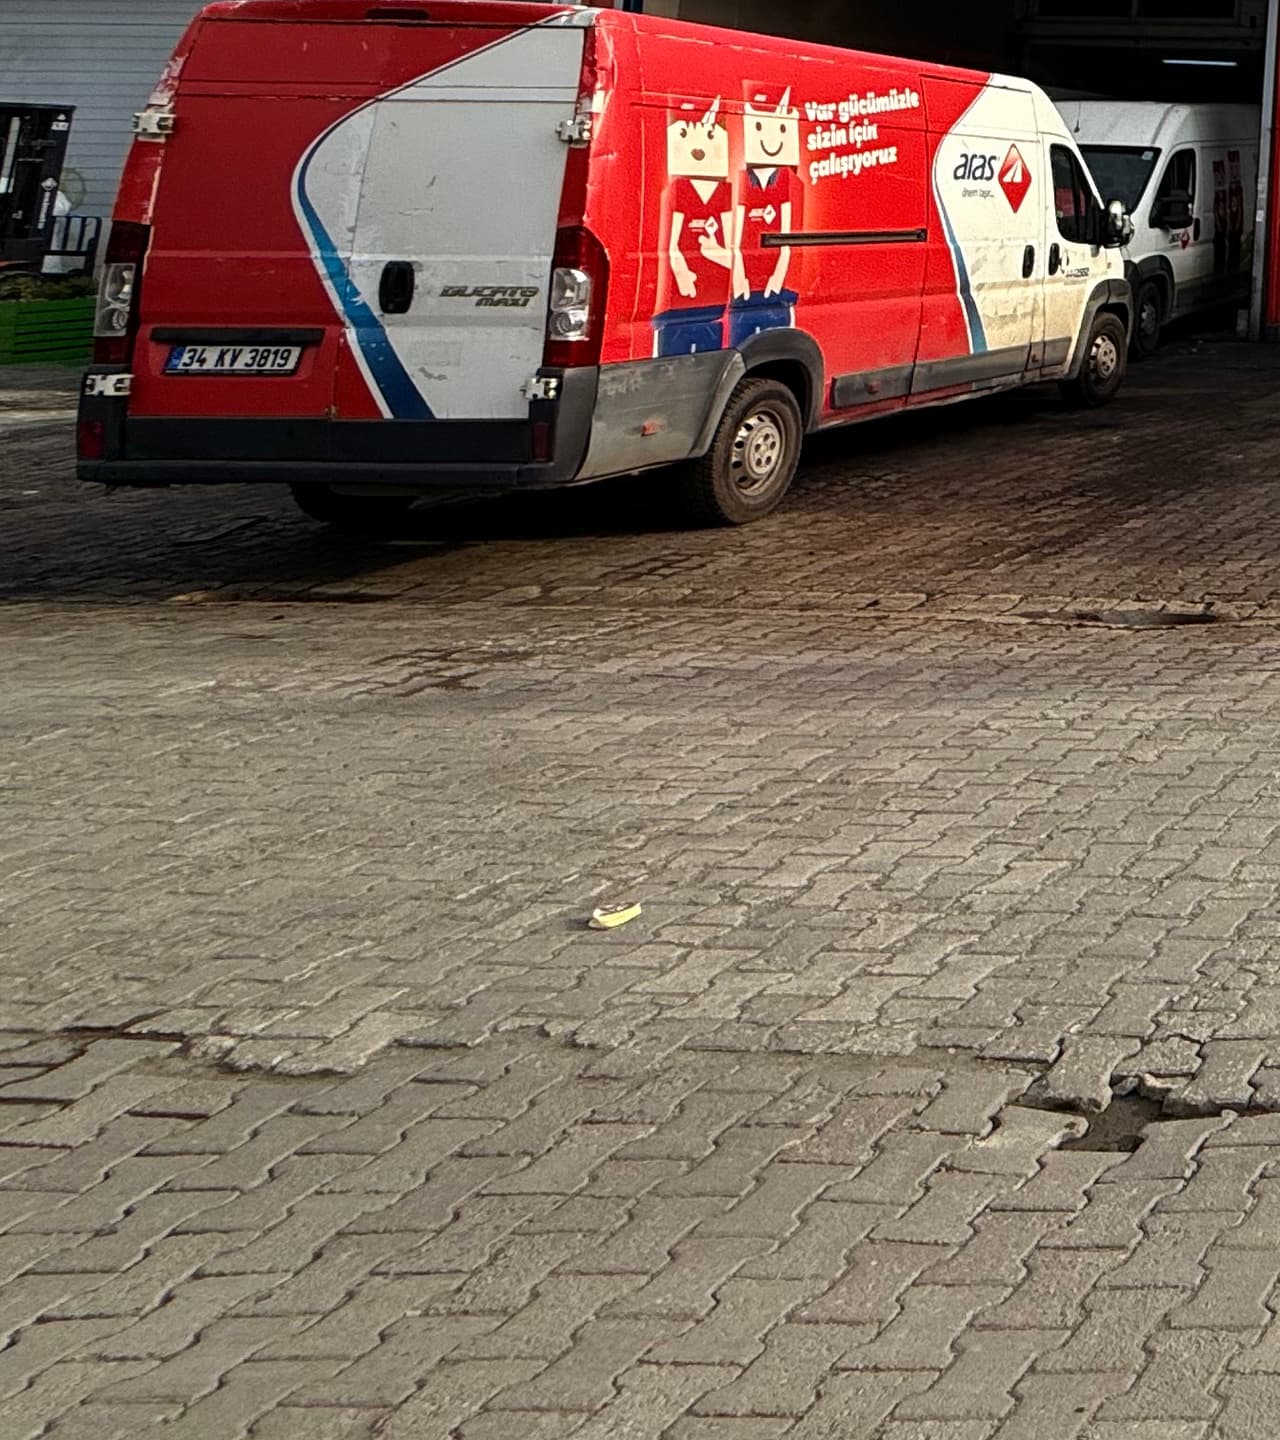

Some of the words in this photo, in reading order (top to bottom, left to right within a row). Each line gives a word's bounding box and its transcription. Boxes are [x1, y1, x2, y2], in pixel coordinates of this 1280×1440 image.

[805, 101, 836, 121] Var
[838, 87, 919, 122] gücümüzle
[807, 125, 847, 151] sizin
[849, 118, 878, 148] için
[809, 146, 897, 185] çalışıyoruz
[953, 153, 997, 181] aras
[439, 286, 540, 297] DUCATO
[475, 298, 530, 307] MAXI
[182, 348, 207, 367] 34
[214, 348, 243, 368] KV
[244, 348, 292, 368] 3819
